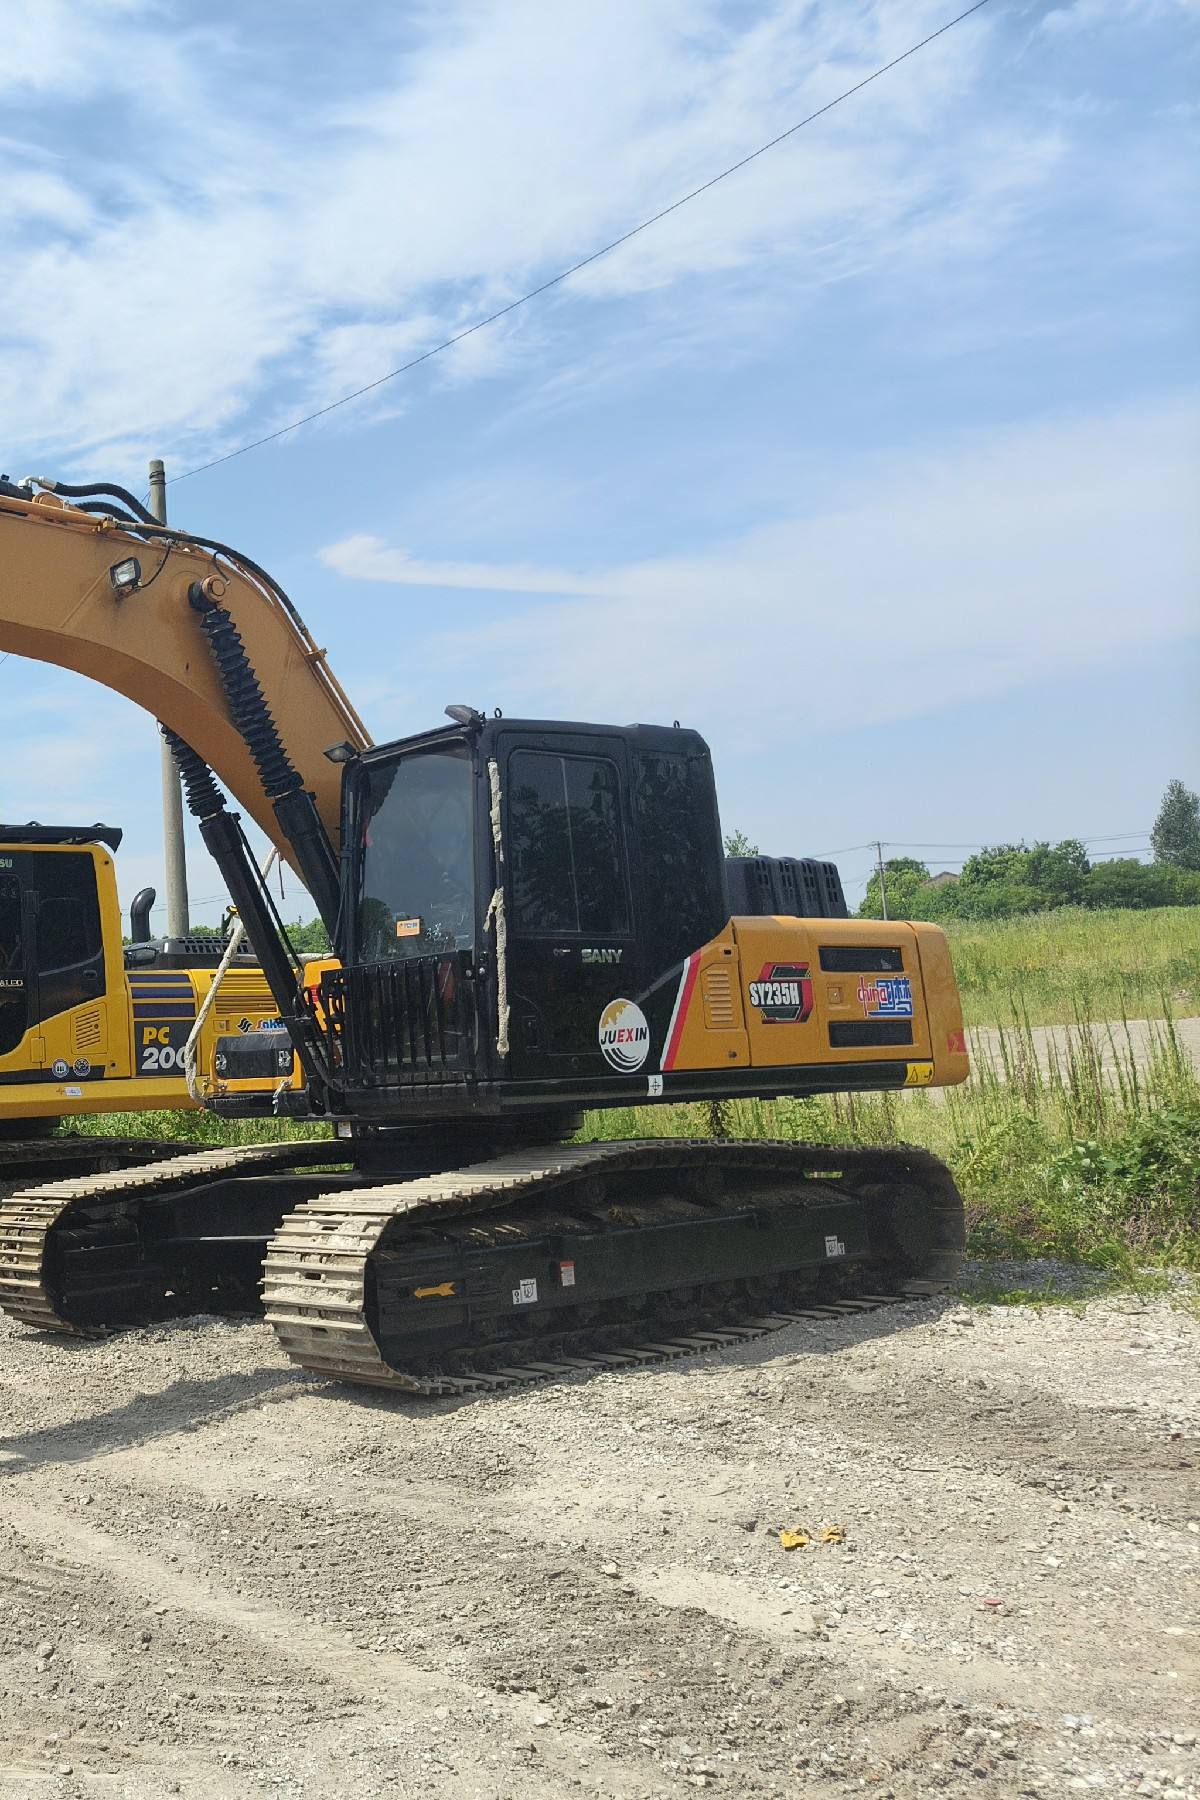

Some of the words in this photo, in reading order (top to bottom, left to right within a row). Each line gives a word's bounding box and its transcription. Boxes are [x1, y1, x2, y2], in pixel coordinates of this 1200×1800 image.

[581, 949, 623, 963] SANY
[750, 983, 799, 1005] SY235H
[143, 1027, 169, 1044] PC
[601, 1027, 647, 1044] JUEXIN
[142, 1046, 188, 1069] 200
